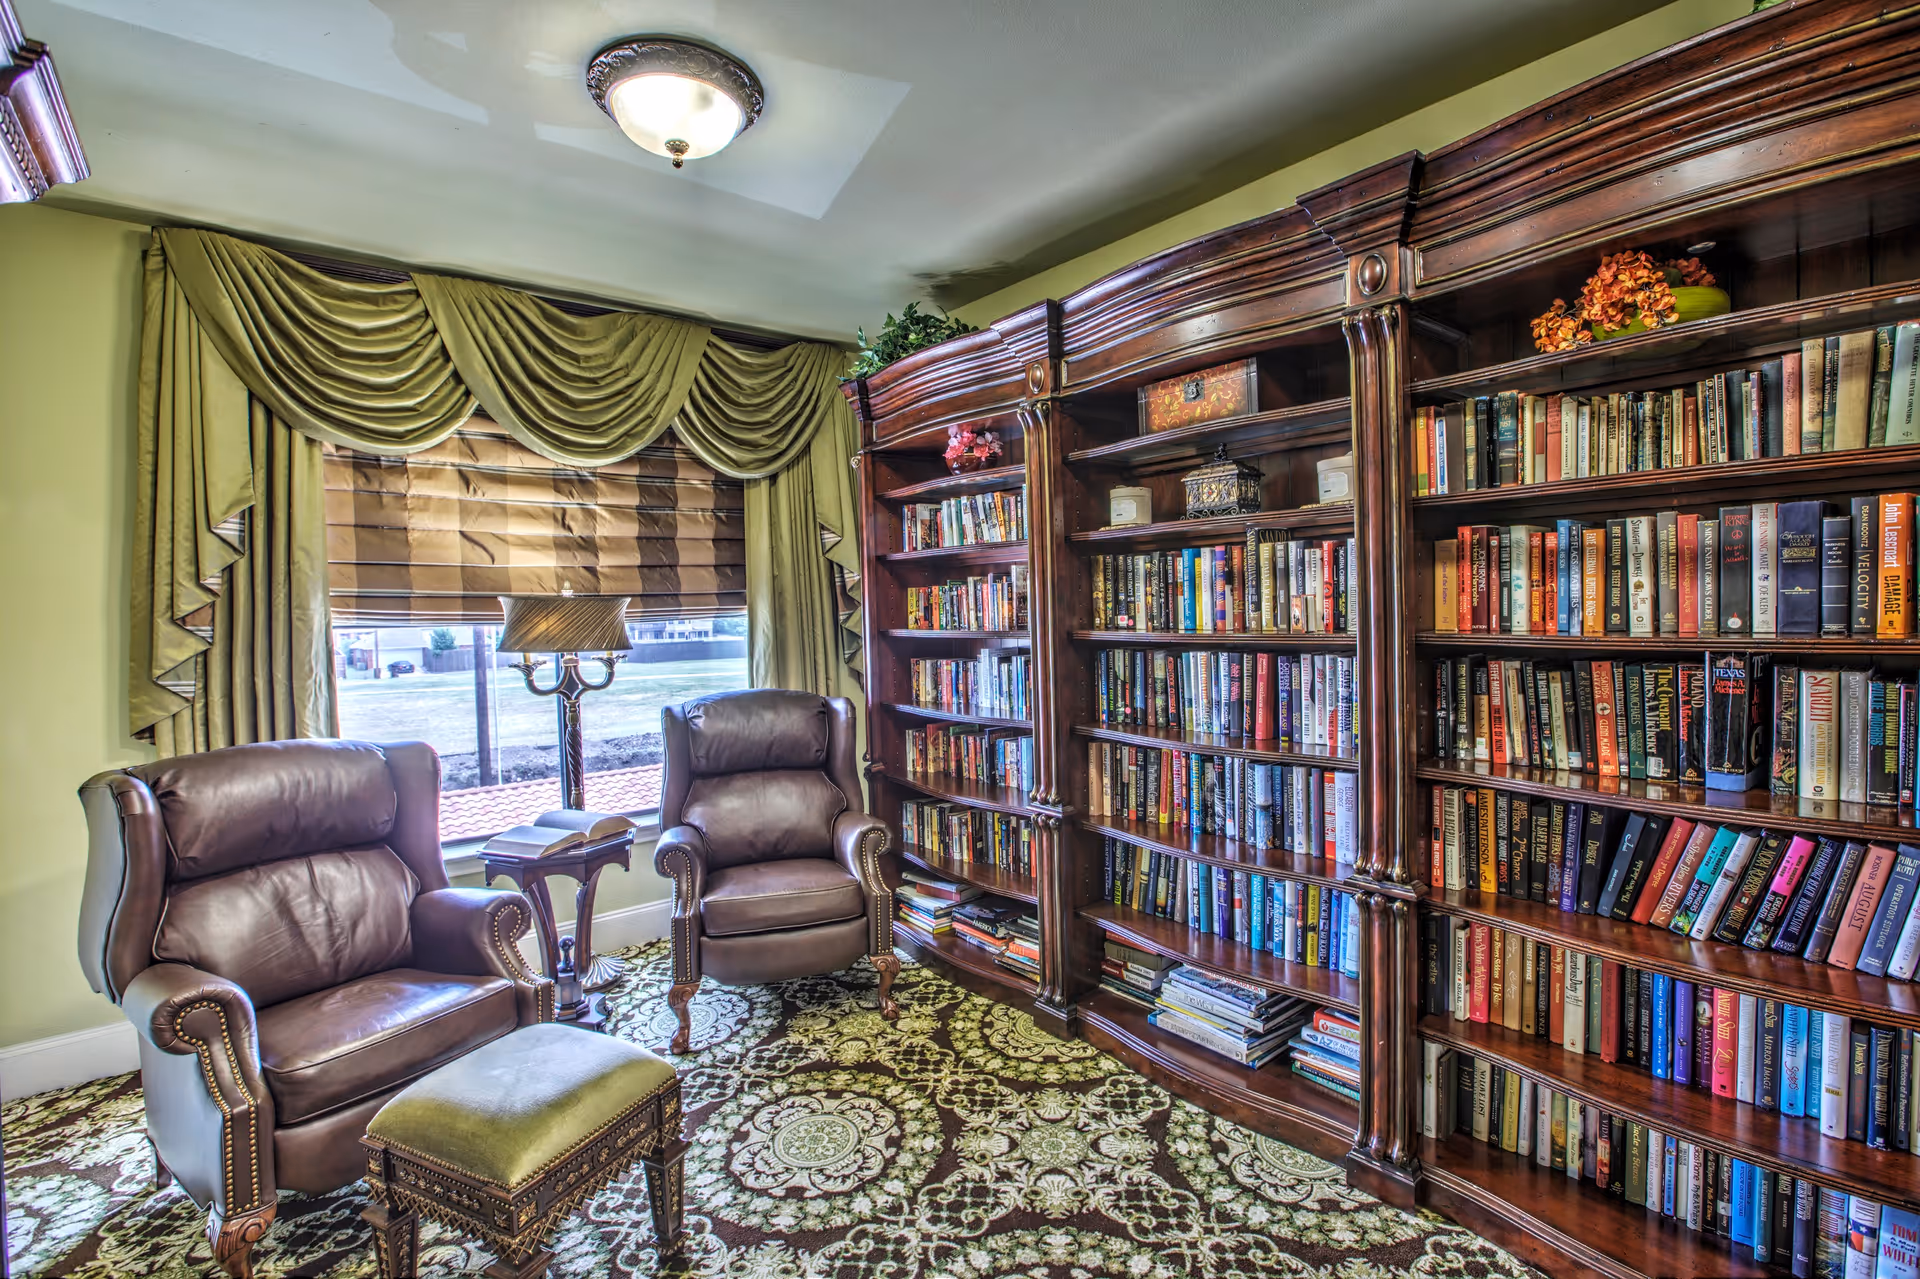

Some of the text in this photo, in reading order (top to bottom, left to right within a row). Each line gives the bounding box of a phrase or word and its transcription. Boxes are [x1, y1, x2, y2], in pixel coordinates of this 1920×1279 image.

[1910, 346, 1919, 378] GEORGETTE
[1908, 378, 1916, 398] HEYER
[1609, 416, 1617, 440] ODYSSEY
[1905, 398, 1915, 425] OMNIBUS
[1247, 530, 1257, 581] SANDRA BROWN
[1630, 520, 1645, 578] STRAIGHT DARKNESS
[1668, 524, 1677, 590] JONATHAN KELLERMAN
[1861, 522, 1869, 548] KOONTZ
[1472, 533, 1480, 607] The Hotel New Hampshire
[1478, 548, 1486, 592] JOHN IRVING
[1570, 542, 1581, 608] FLAGS FATHERS
[1704, 528, 1713, 620] MINE ENEMY GROWS OLDER
[1760, 508, 1769, 615] THE RUNNING MATE JOE KLEIN
[1884, 502, 1902, 616] John Lescroart DAMAGE
[1858, 554, 1870, 610] VELOCITY
[1690, 670, 1705, 708] POLAND
[1714, 668, 1746, 679] TEXAS
[1630, 676, 1641, 725] FERN MICHAELS
[1643, 668, 1661, 754] James A. Michener
[1656, 667, 1674, 731] The Covenant
[1780, 676, 1796, 742] Judith Michael
[1806, 676, 1833, 724] SCARLETT
[1870, 682, 1884, 747] WILLIE MORRIS
[1600, 719, 1611, 756] GLENN MEADE
[1849, 676, 1859, 786] DAVID MORRELL DOUBLE IMAGE
[1885, 683, 1899, 774] NORTH TOWARD HOME
[1337, 788, 1345, 807] GEORGE
[1345, 786, 1354, 812] ELIZABETH
[1512, 800, 1520, 832] PATTERSON
[1520, 802, 1528, 819] JAMES
[1480, 793, 1490, 866] JAMES PATTERSON
[1536, 816, 1548, 864] NO SAFE PLACE
[1552, 806, 1564, 856] ELIZABETH PETERS
[1512, 836, 1527, 881] 2nd Chance
[1676, 864, 1690, 881] Blew
[1684, 844, 1700, 866] Shofar
[1837, 850, 1859, 892] DEAR ROGUE
[1660, 880, 1684, 915] RIVERS
[1684, 888, 1698, 906] DEATH
[1690, 884, 1709, 913] STRANGERS
[1724, 848, 1776, 931] NORA ROBERTS TRIBUTE
[1758, 900, 1772, 919] DEATH
[1766, 896, 1784, 923] CREATION
[1850, 856, 1883, 932] ROSSNER AUGUST
[972, 919, 993, 934] AMERICA
[1876, 884, 1904, 950] OPERATION SHYLOCK
[1125, 974, 1141, 984] Florida
[1717, 989, 1736, 1041] DANIELLE STEEL
[1319, 1036, 1333, 1048] A-Z
[1696, 1026, 1704, 1063] SPENCER
[1764, 1013, 1778, 1089] STEEL MIRROR IMAGE
[1828, 1022, 1843, 1075] DANIELLE STEEL
[1854, 1042, 1867, 1076] DANIELLE STEEL
[1900, 1054, 1909, 1085] Reflections
[1479, 1070, 1487, 1117] NO LOVE LOST
[1898, 1098, 1907, 1132] Peacemaker
[1631, 1123, 1642, 1186] Circle of Stones
[1818, 1192, 1845, 1244] Hill Country
[1892, 1223, 1917, 1243] TOM
